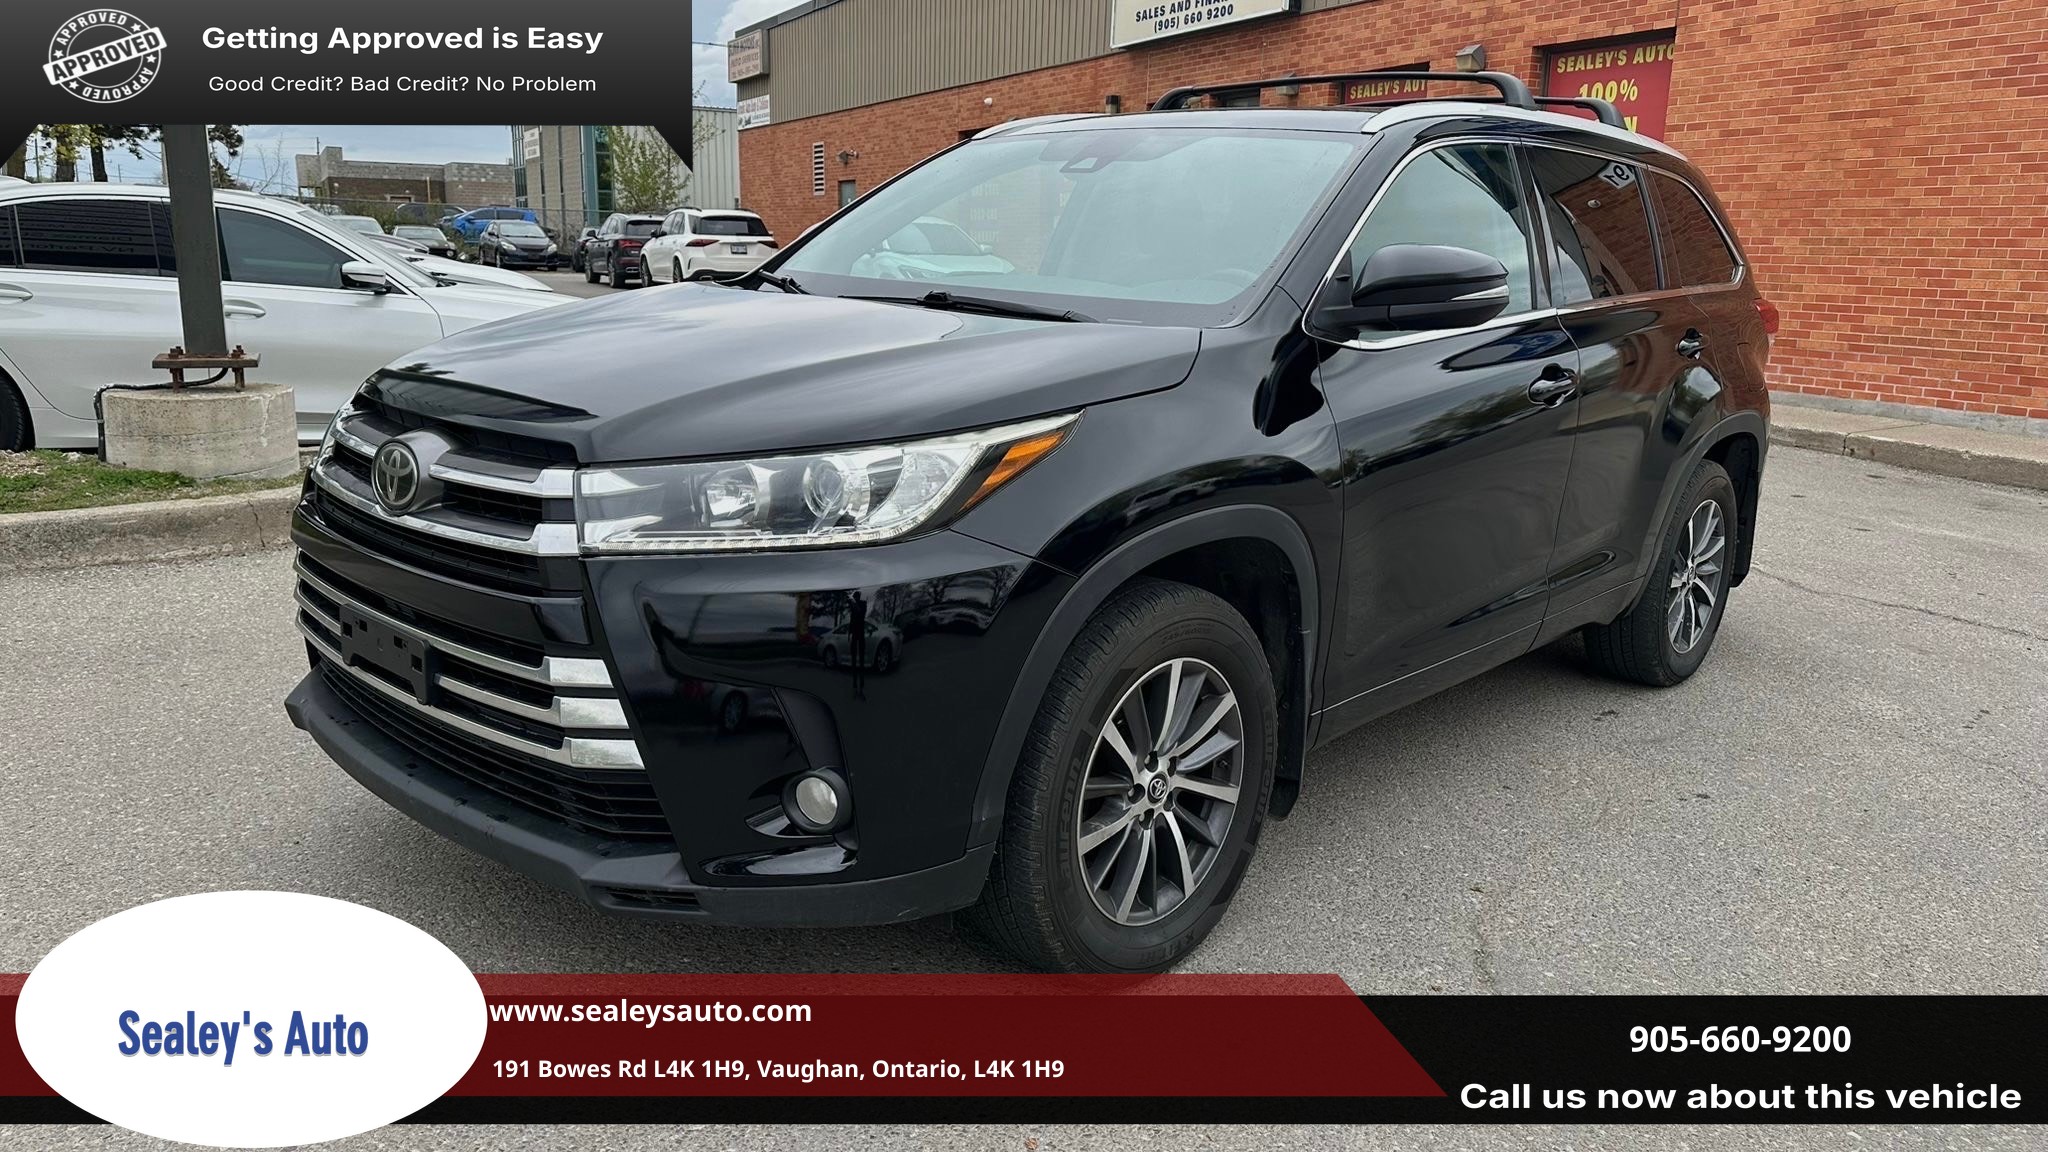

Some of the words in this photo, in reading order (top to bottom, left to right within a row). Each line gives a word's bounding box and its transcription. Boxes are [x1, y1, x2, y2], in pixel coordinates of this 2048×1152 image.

[1135, 5, 1166, 22] SALES
[1169, 0, 1191, 14] AND
[1194, 0, 1229, 8] FIN
[1154, 16, 1180, 33] (905)
[1183, 11, 1203, 25] 660
[1206, 4, 1234, 20] 9200
[1557, 49, 1628, 74] SEALEY'S
[1632, 43, 1675, 65] AUTO
[1349, 80, 1400, 99] SEALEY'S
[1579, 78, 1639, 103] 100%
